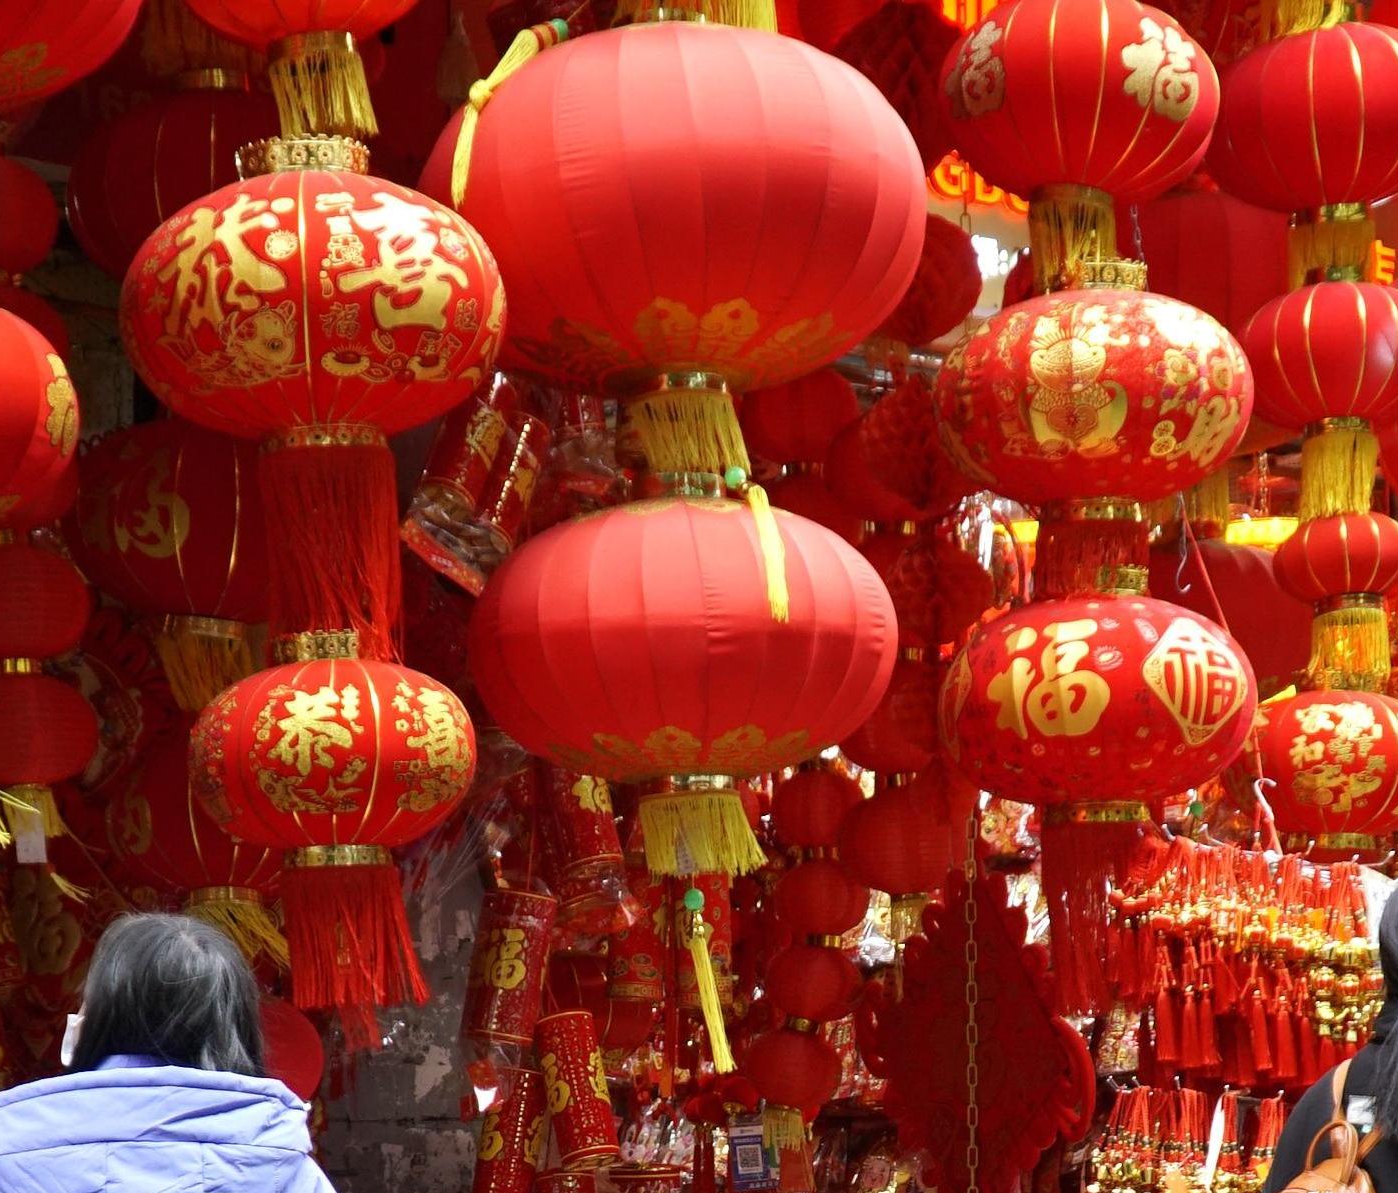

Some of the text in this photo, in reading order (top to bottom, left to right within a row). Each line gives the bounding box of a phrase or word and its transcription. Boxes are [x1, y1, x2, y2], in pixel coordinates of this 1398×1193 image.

[1121, 17, 1198, 122] 福
[987, 618, 1111, 740] 福
[1163, 632, 1244, 731] 福
